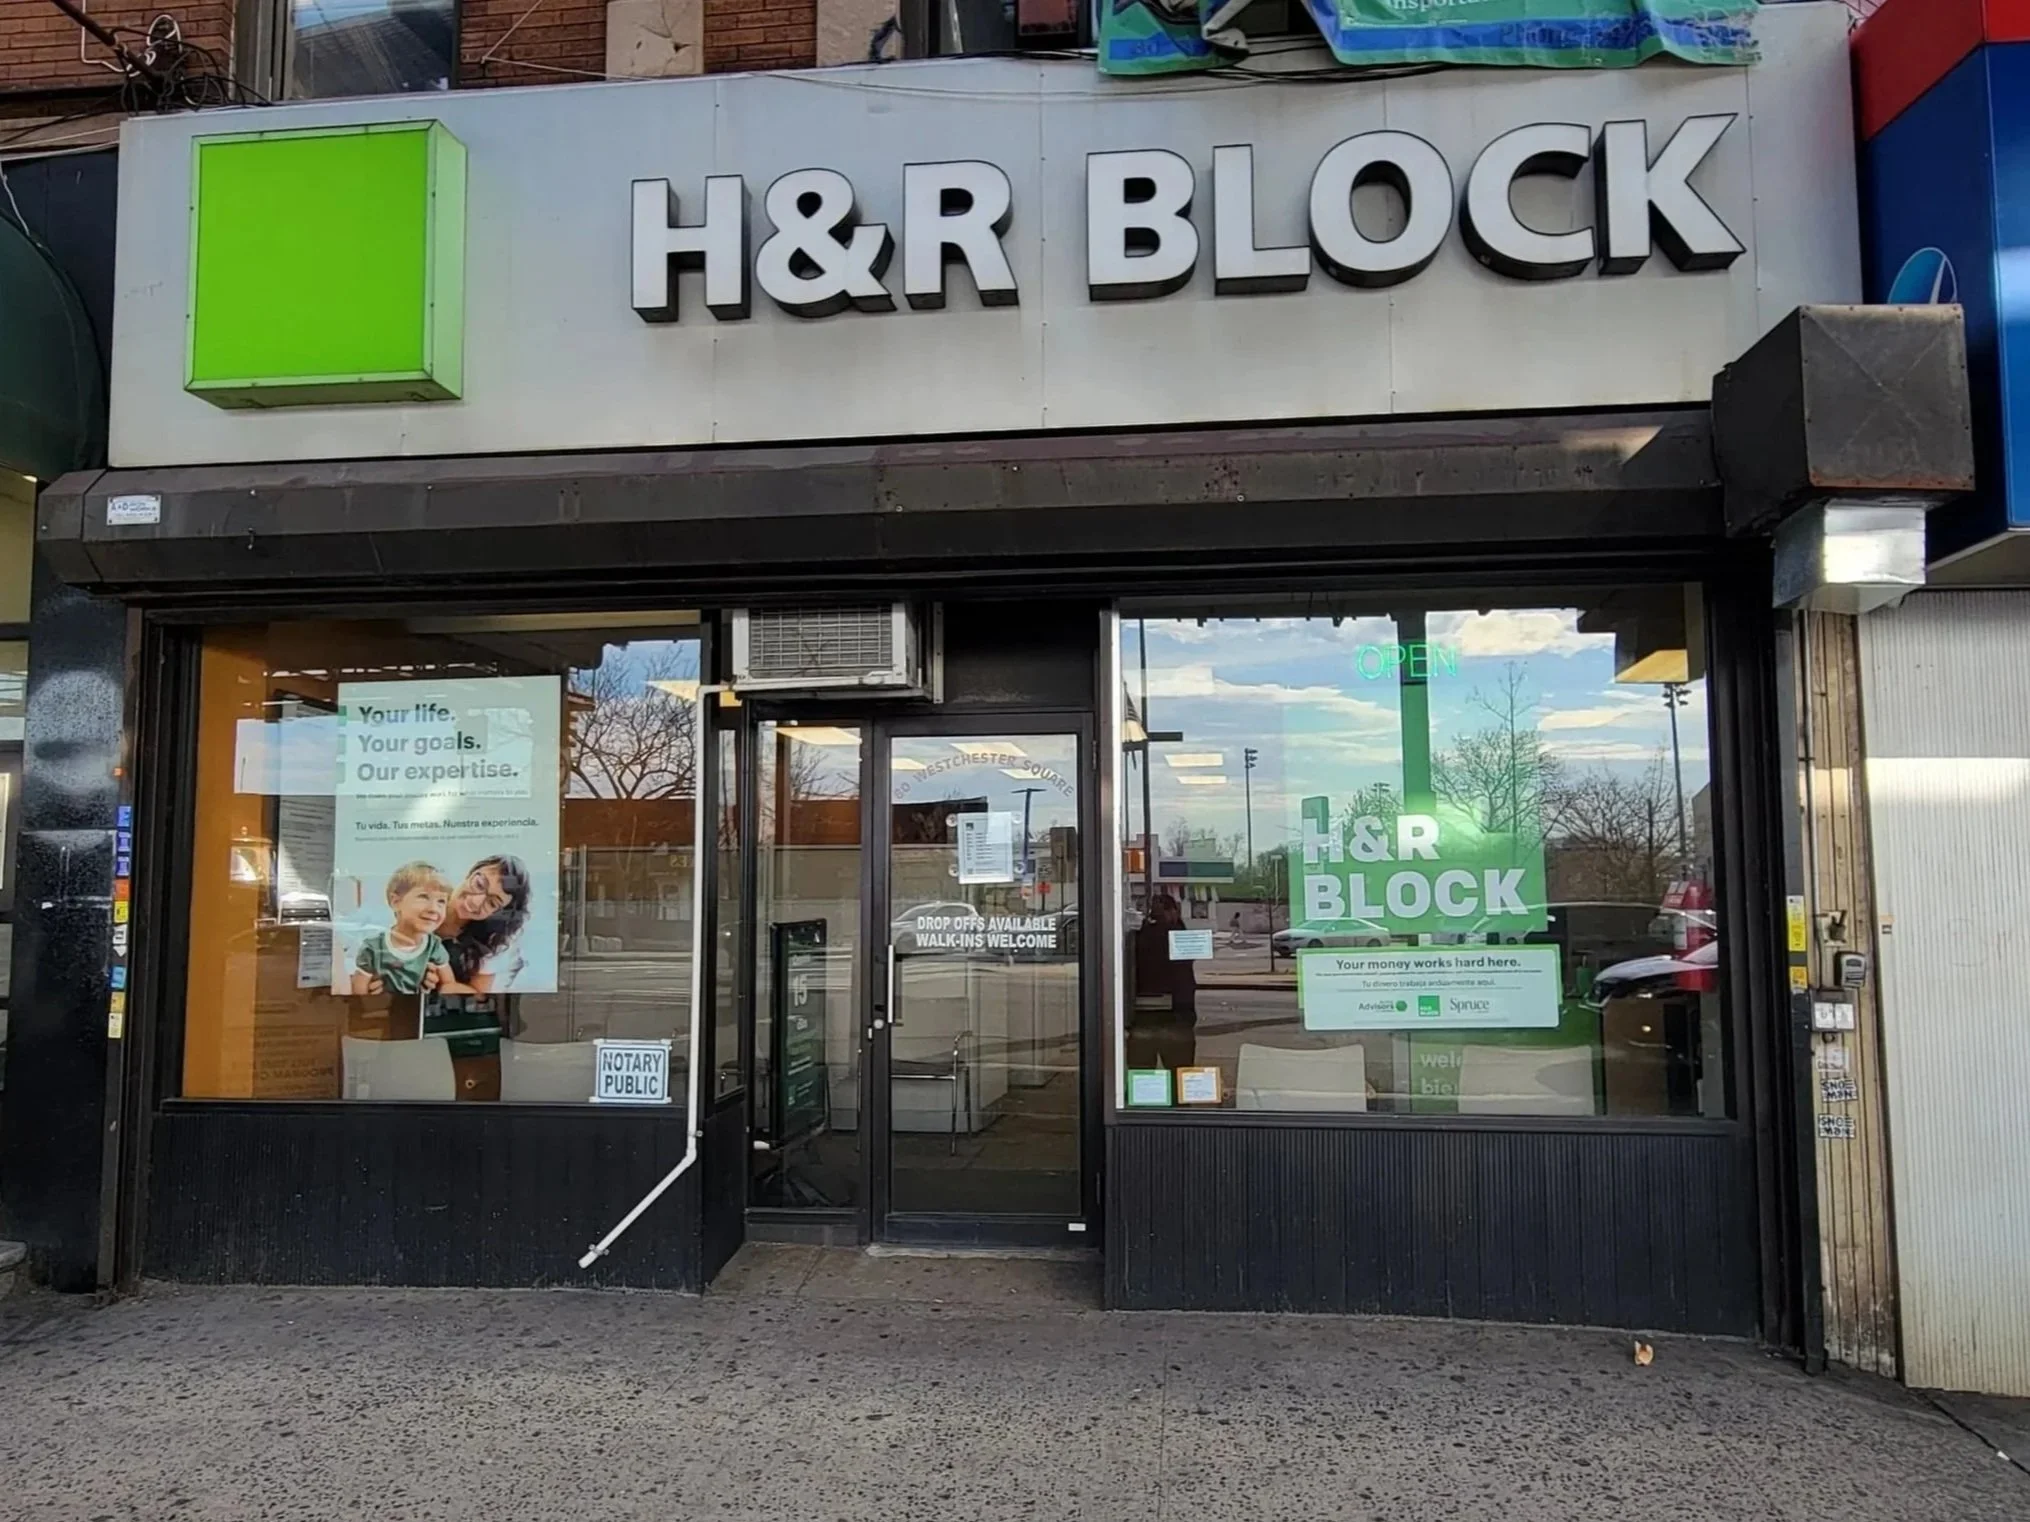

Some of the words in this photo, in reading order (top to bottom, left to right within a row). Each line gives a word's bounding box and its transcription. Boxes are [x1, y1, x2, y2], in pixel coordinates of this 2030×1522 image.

[631, 159, 1020, 322] H&R
[1086, 112, 1747, 303] BLOCK
[1357, 643, 1458, 680] OPEN
[358, 705, 411, 725] Your
[415, 703, 457, 723] life.
[358, 734, 410, 754] Your
[414, 731, 482, 756] goals.
[357, 763, 400, 782] Our
[405, 758, 520, 784] expertise.
[912, 752, 1017, 784] WESTCHESTER
[1022, 759, 1075, 798] SQUARE
[355, 821, 367, 830] Tu
[368, 821, 391, 830] vida.
[393, 820, 409, 830] Tus
[410, 820, 442, 829] metas.
[443, 819, 480, 828] Nuestra
[481, 817, 540, 829] experiencia.
[1302, 814, 1441, 864] H&R
[1304, 868, 1529, 921] BLOCK
[916, 916, 951, 931] DROP
[953, 916, 986, 931] OFFS
[988, 916, 1057, 931] AVAILABLE
[915, 933, 984, 948] WALK-INS
[986, 934, 1057, 949] WELCOME
[1336, 959, 1366, 971] Your
[1368, 959, 1411, 971] money
[1414, 958, 1453, 969] works
[1455, 956, 1485, 968] hard
[1488, 955, 1522, 967] here.
[1449, 997, 1491, 1014] Spruce
[602, 1052, 662, 1073] NOTARY
[604, 1074, 659, 1095] PUBLIC
